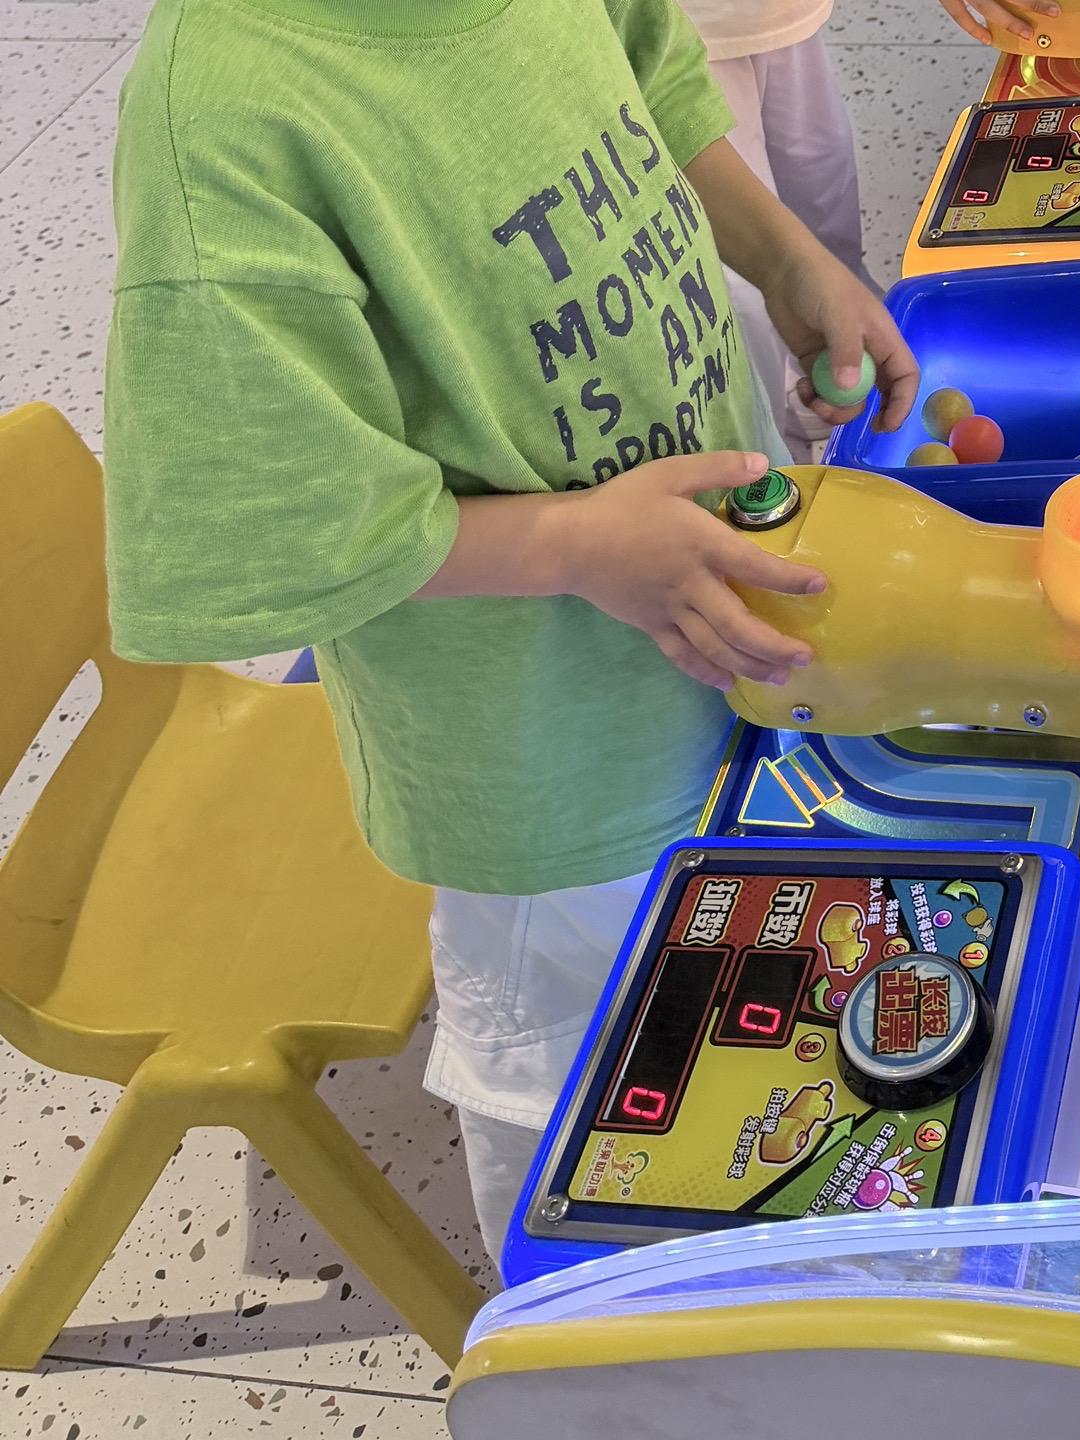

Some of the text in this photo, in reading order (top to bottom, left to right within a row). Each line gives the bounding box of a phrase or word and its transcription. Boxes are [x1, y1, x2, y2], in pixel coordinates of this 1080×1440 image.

[492, 101, 660, 283] THIS
[553, 258, 719, 463] IS AN
[687, 879, 743, 946] 球数
[761, 881, 814, 947] 币数
[739, 1004, 781, 1035] 0
[874, 969, 919, 1056] 出票
[919, 977, 953, 1038] 长按
[623, 1087, 666, 1120] 0
[760, 1088, 787, 1133] 拍按键
[726, 1115, 760, 1179] 发射彩球
